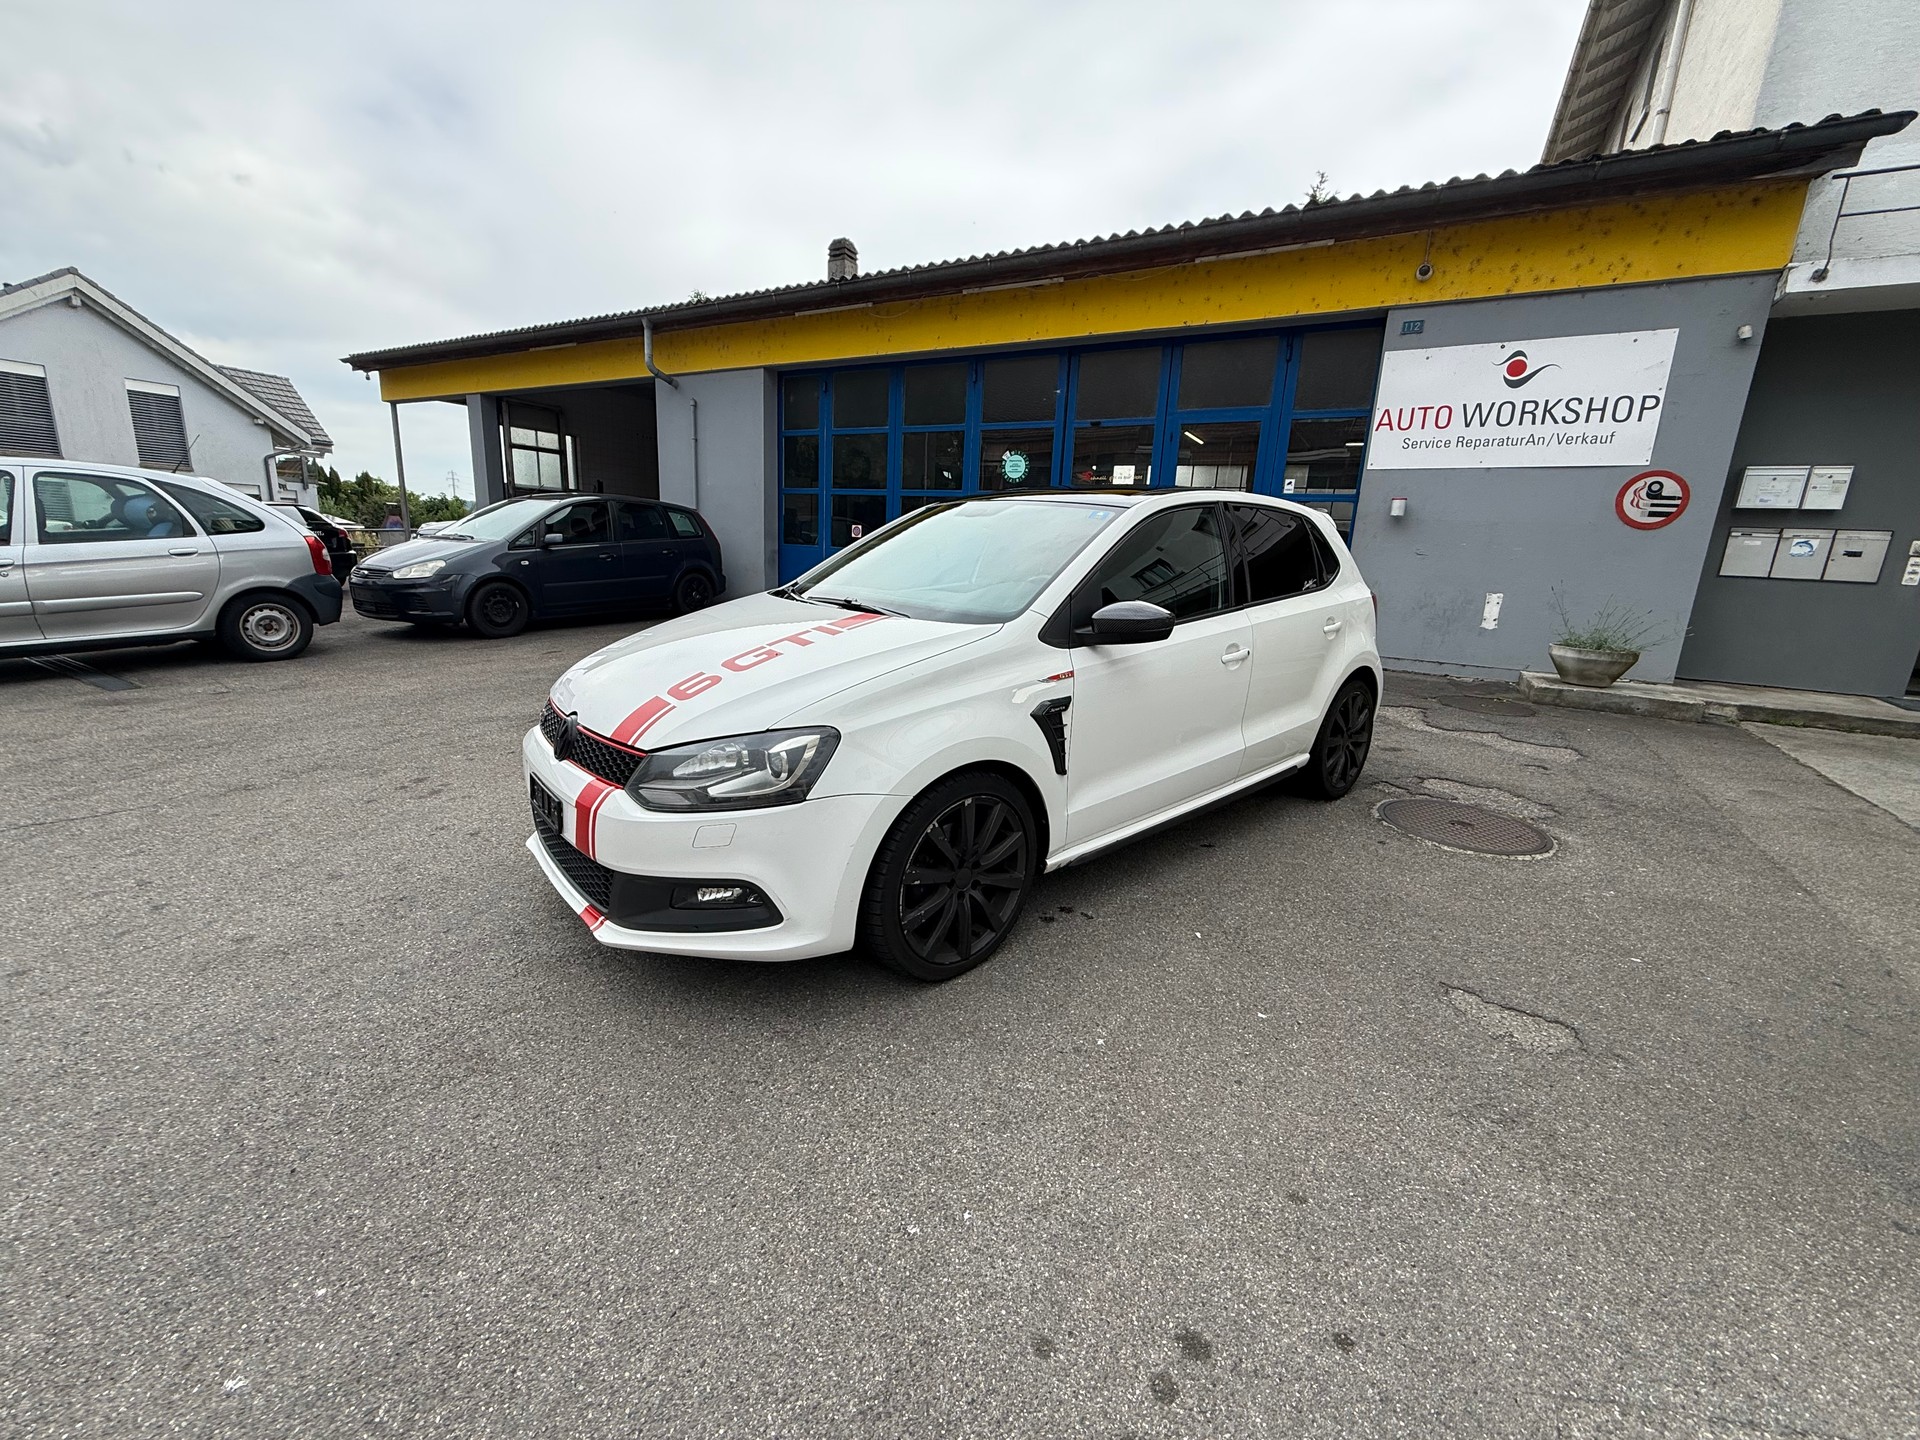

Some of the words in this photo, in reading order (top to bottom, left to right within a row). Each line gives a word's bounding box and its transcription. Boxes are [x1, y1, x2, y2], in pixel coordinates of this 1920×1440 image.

[1404, 321, 1421, 331] 112
[1375, 404, 1453, 432] AUTO
[1462, 394, 1661, 429] WORKSHOP
[1402, 436, 1452, 450] Service
[1455, 431, 1617, 451] ReparaturAn/Verkauf
[720, 625, 844, 673] GTI
